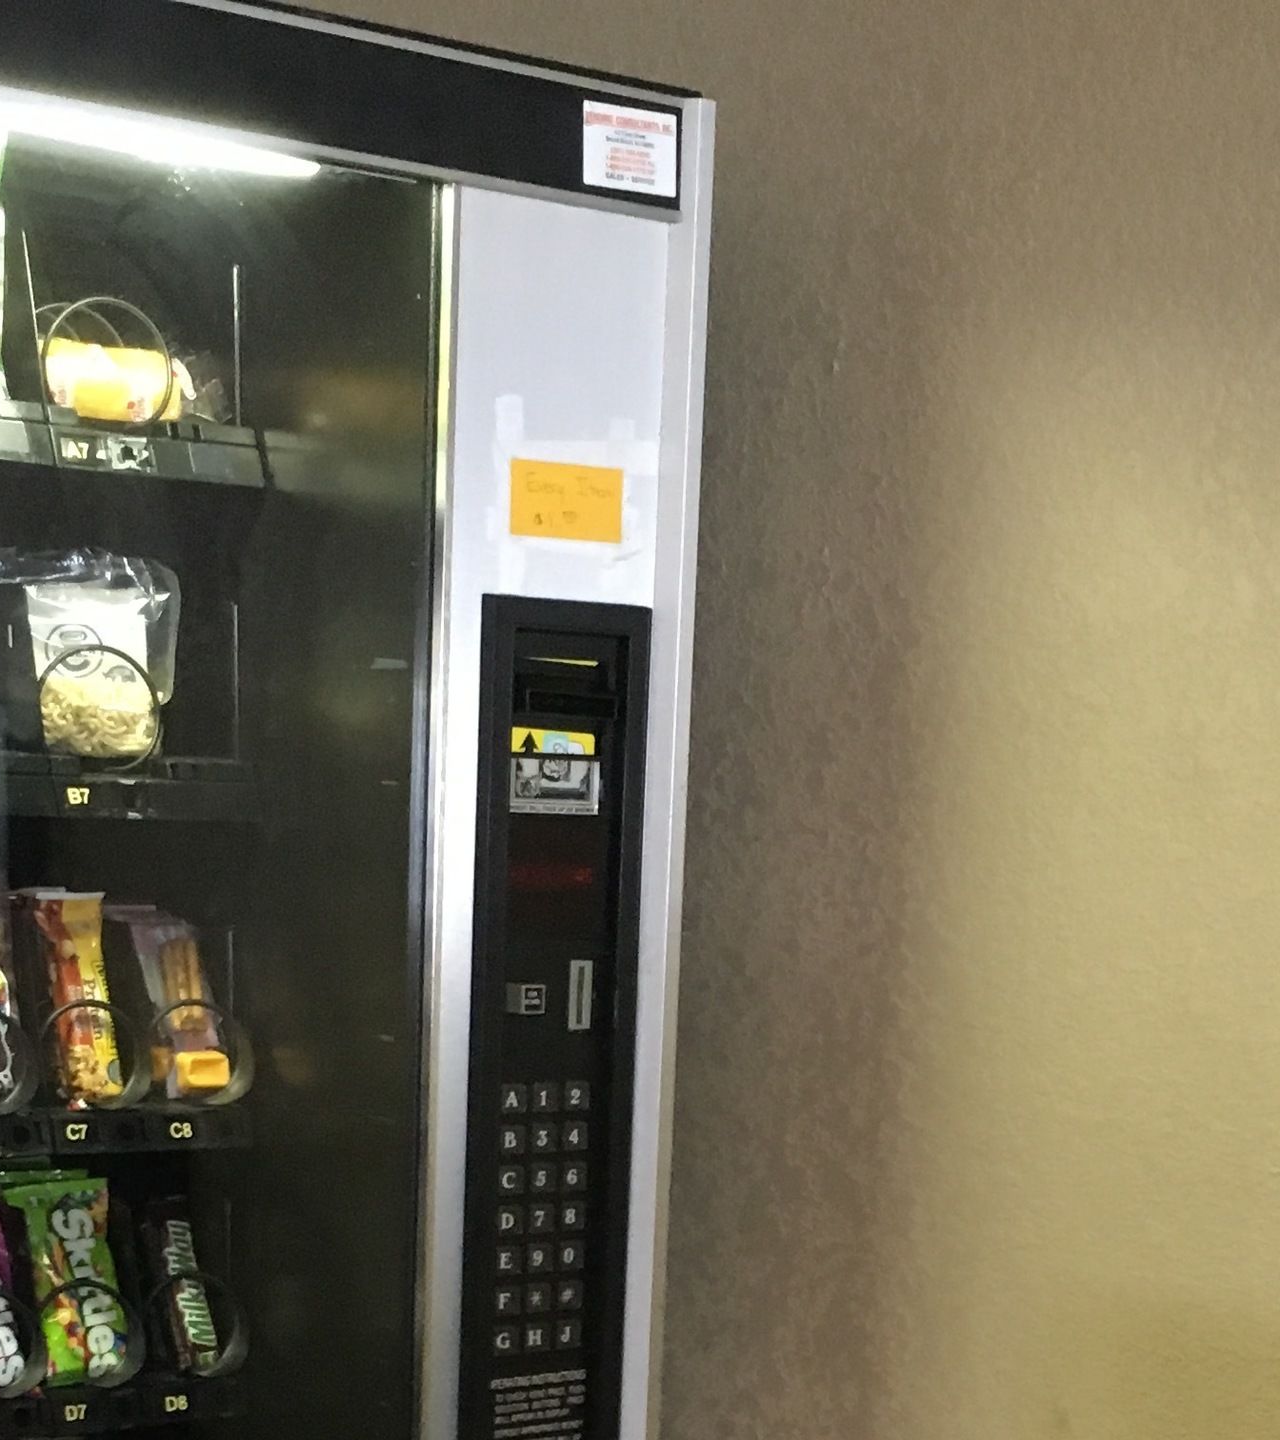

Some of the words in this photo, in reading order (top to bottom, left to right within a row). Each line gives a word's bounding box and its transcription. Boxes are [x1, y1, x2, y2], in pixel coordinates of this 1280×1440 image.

[67, 441, 89, 460] A7
[66, 787, 90, 805] B7
[505, 1090, 518, 1108] A
[539, 1090, 547, 1106] 1
[570, 1088, 581, 1105] 2
[66, 1123, 88, 1141] C7
[169, 1122, 193, 1139] C8
[503, 1131, 517, 1148] B
[536, 1130, 548, 1147] 3
[568, 1128, 579, 1144] 4
[501, 1171, 516, 1189] C
[535, 1170, 547, 1187] 5
[566, 1168, 578, 1185] 6
[500, 1212, 515, 1229] D
[534, 1210, 545, 1227] 7
[564, 1208, 576, 1224] 8
[499, 1252, 513, 1270] E
[532, 1250, 544, 1267] 9
[563, 1247, 575, 1264] 0
[50, 1206, 124, 1379] Skittles
[498, 1292, 511, 1310] F
[495, 1332, 511, 1349] G
[527, 1329, 543, 1346] H
[560, 1326, 572, 1343] J
[64, 1404, 87, 1422] D7
[164, 1395, 188, 1412] D8
